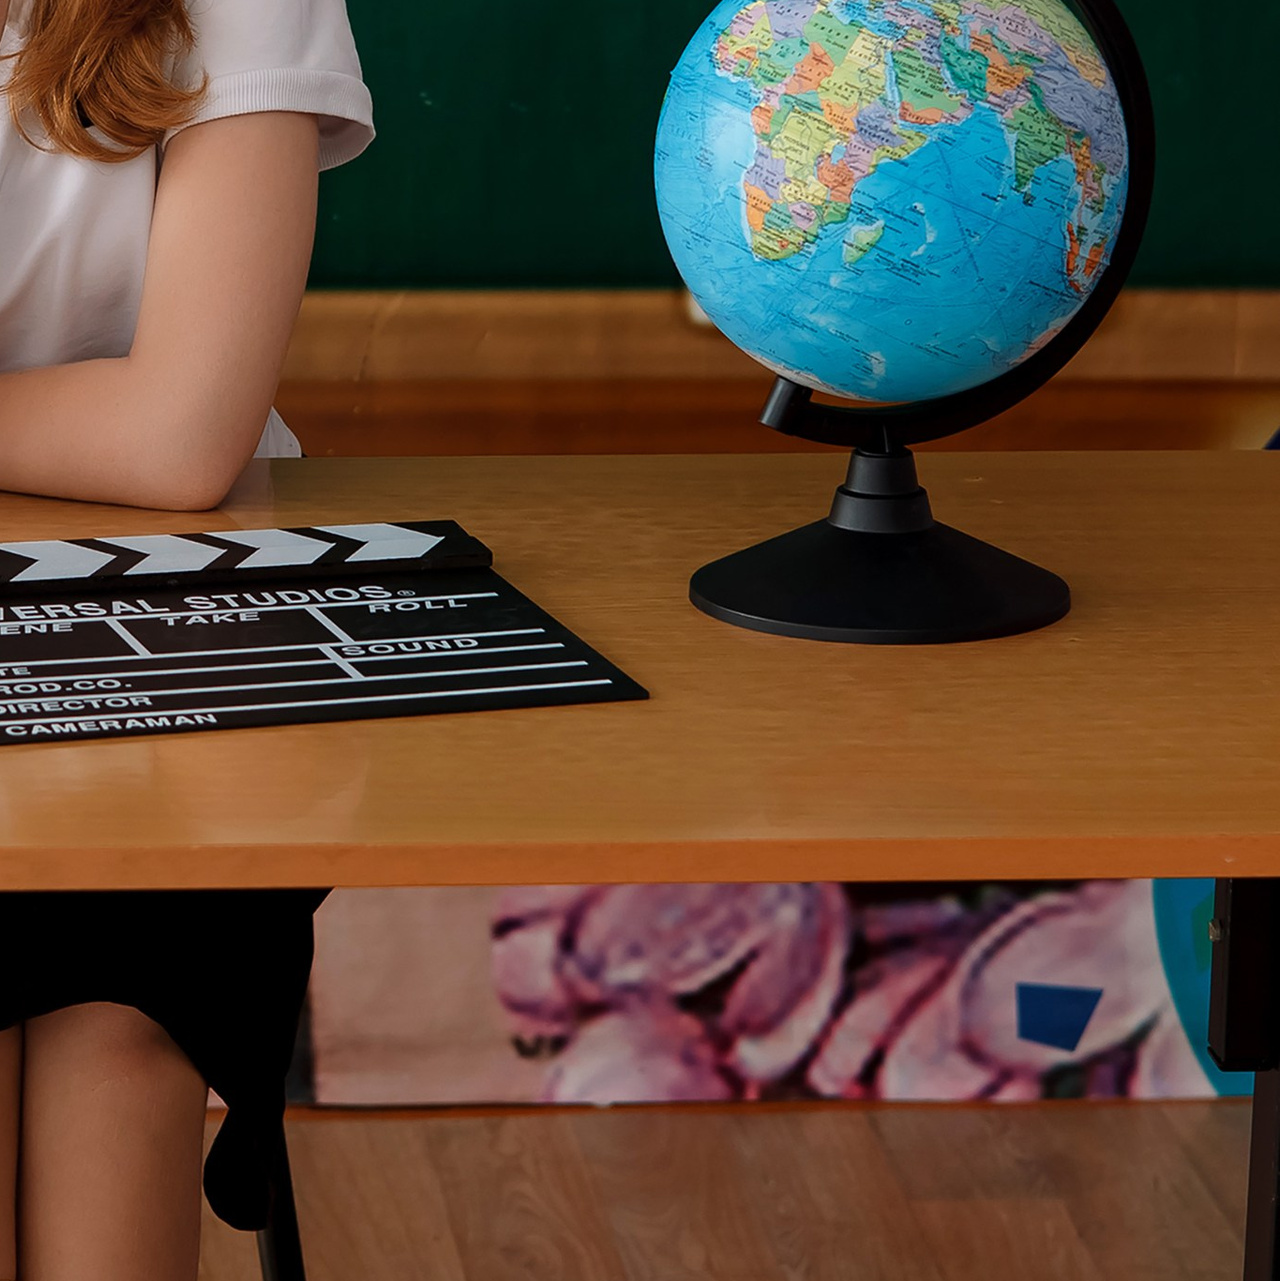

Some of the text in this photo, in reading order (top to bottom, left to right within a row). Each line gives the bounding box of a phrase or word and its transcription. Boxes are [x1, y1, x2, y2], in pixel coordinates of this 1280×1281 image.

[183, 585, 393, 610] STUDIOS
[369, 598, 468, 613] ROLL
[160, 611, 261, 626] TAKE
[341, 638, 479, 656] SOUND
[5, 713, 218, 736] CAMERAMAN
